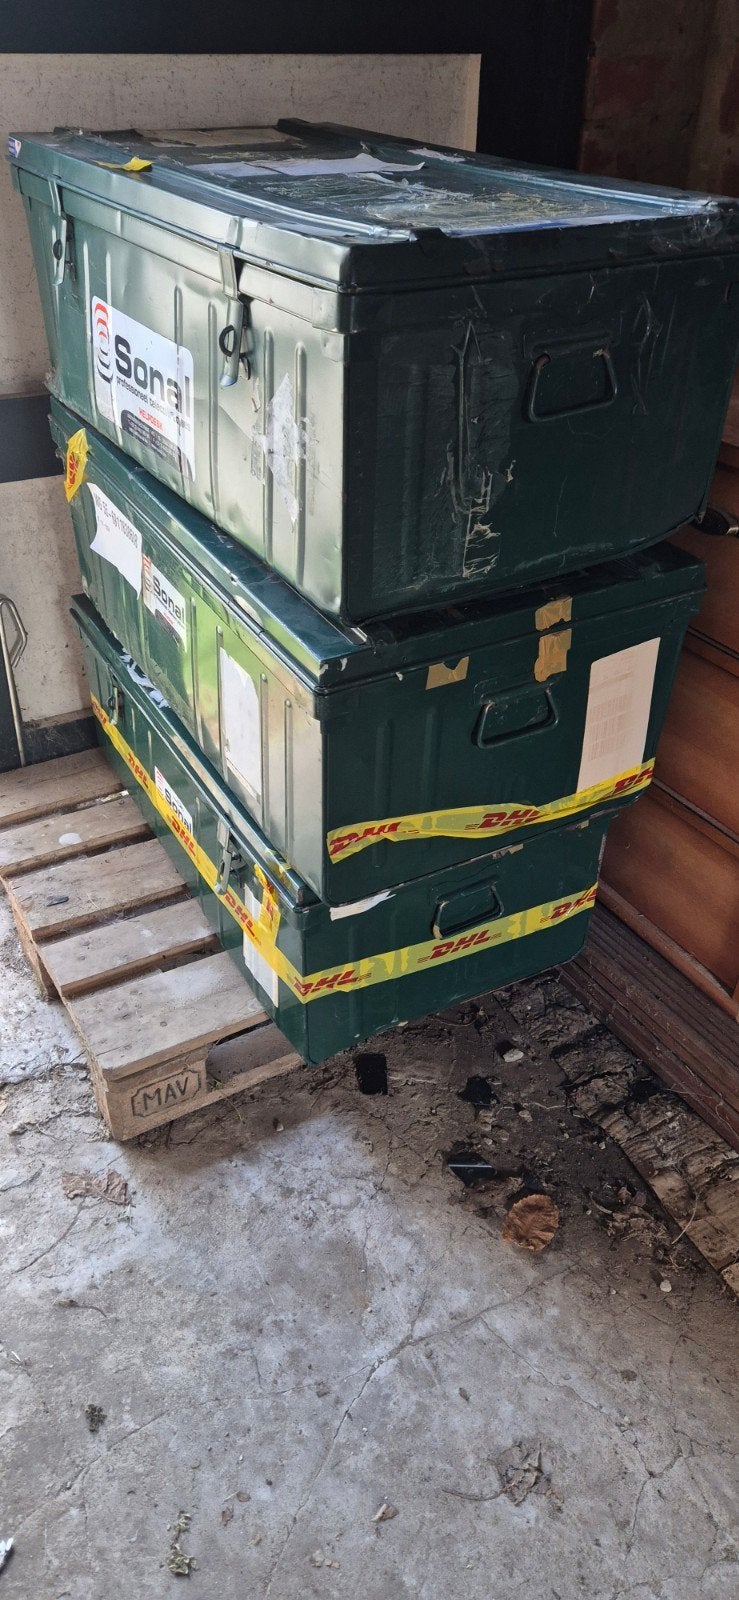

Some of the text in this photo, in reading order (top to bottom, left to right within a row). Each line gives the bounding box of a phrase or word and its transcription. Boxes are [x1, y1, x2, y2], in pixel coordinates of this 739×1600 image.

[114, 335, 190, 417] Sonal
[153, 575, 185, 620] Sonal
[164, 788, 192, 834] Sonal
[171, 815, 196, 857] DHL
[224, 891, 255, 938] DHL
[429, 929, 491, 960] DHL
[293, 969, 358, 997] DHL
[143, 1076, 188, 1111] MAV
